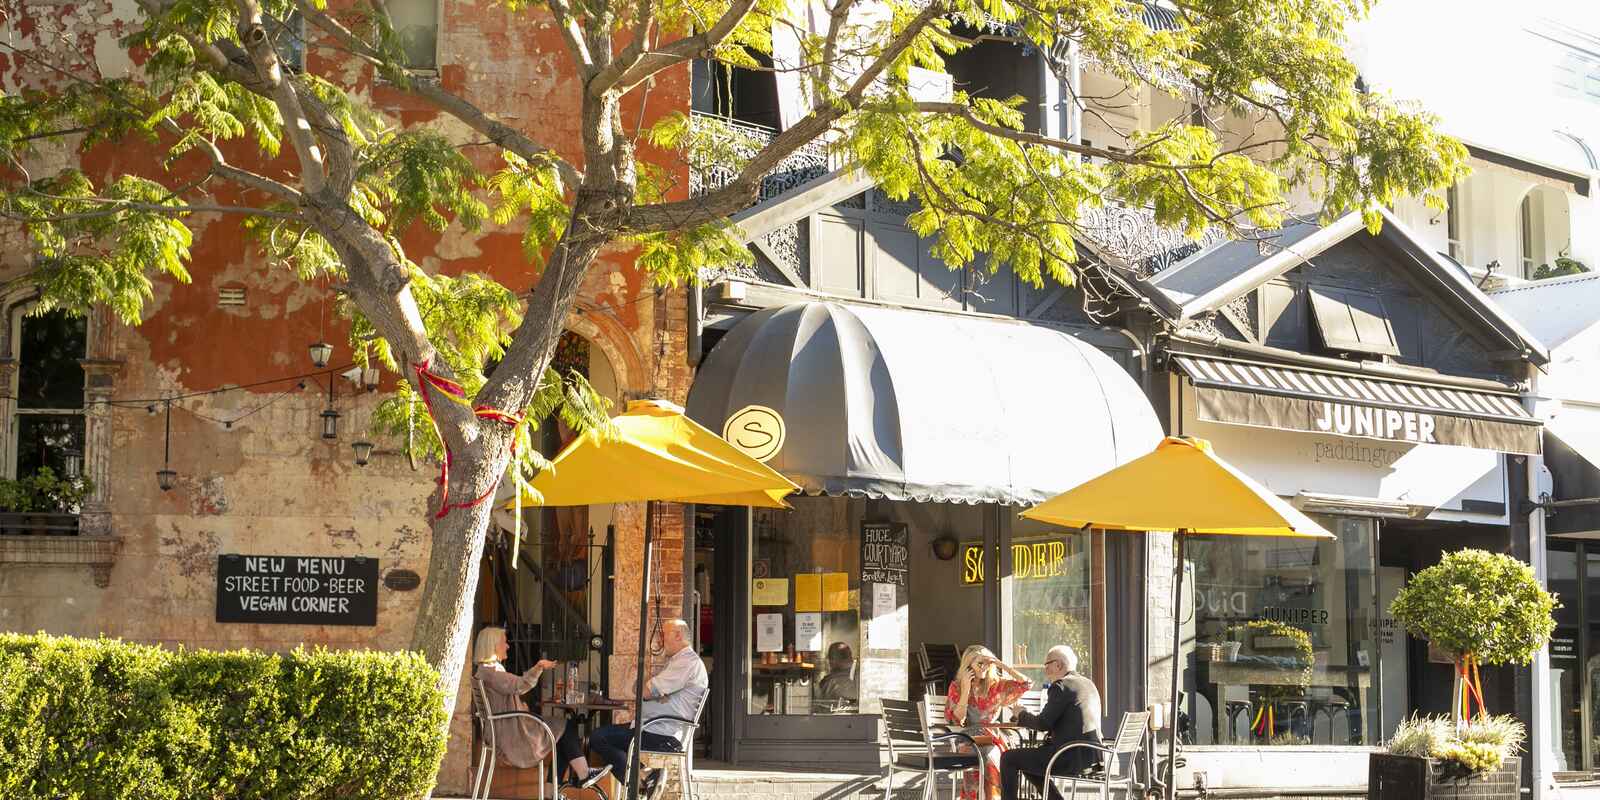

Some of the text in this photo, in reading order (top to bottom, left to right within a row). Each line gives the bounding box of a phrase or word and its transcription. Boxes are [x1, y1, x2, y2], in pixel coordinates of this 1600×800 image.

[1317, 401, 1436, 443] JUNIPER
[736, 421, 773, 449] S
[865, 529, 892, 543] HUGE
[864, 543, 908, 569] COURTYARD
[965, 541, 1068, 583] SDER
[245, 557, 346, 575] NEW MENU
[225, 576, 280, 592] STREET
[284, 577, 320, 593] FOOD
[240, 596, 350, 614] VEGAN CORNER
[1261, 606, 1329, 625] JUNIPER
